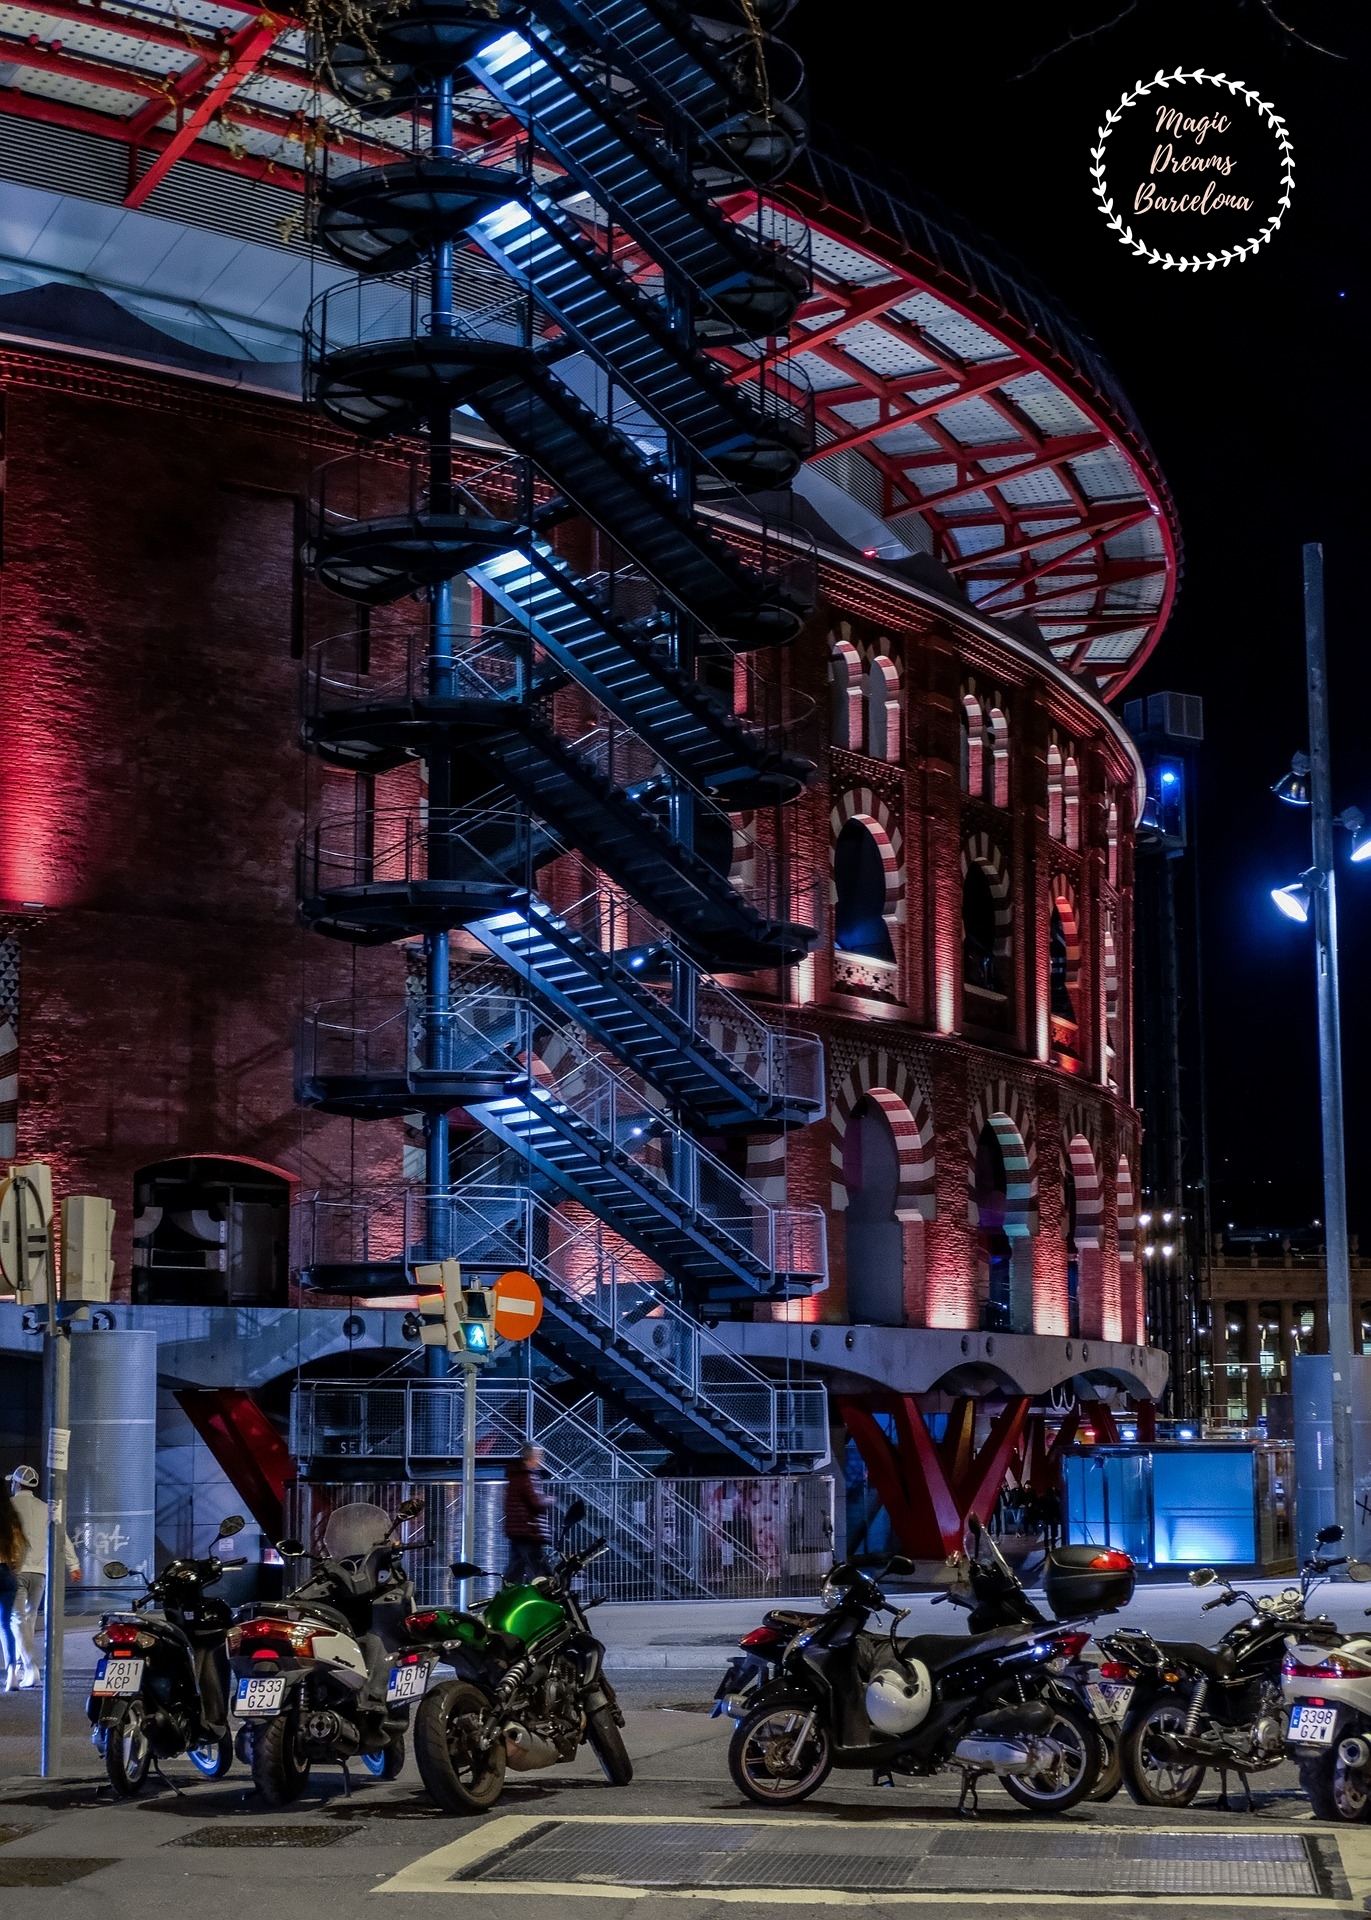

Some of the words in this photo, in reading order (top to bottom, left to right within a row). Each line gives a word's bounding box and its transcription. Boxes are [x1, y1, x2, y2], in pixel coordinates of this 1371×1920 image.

[109, 1662, 139, 1675] 7811
[400, 1665, 427, 1682] 1618
[105, 1676, 130, 1689] KCP
[249, 1680, 282, 1693] 9533
[395, 1682, 416, 1697] HZL
[1104, 1686, 1131, 1700] 5778
[247, 1694, 275, 1708] GZJ
[1301, 1709, 1333, 1725] 3398
